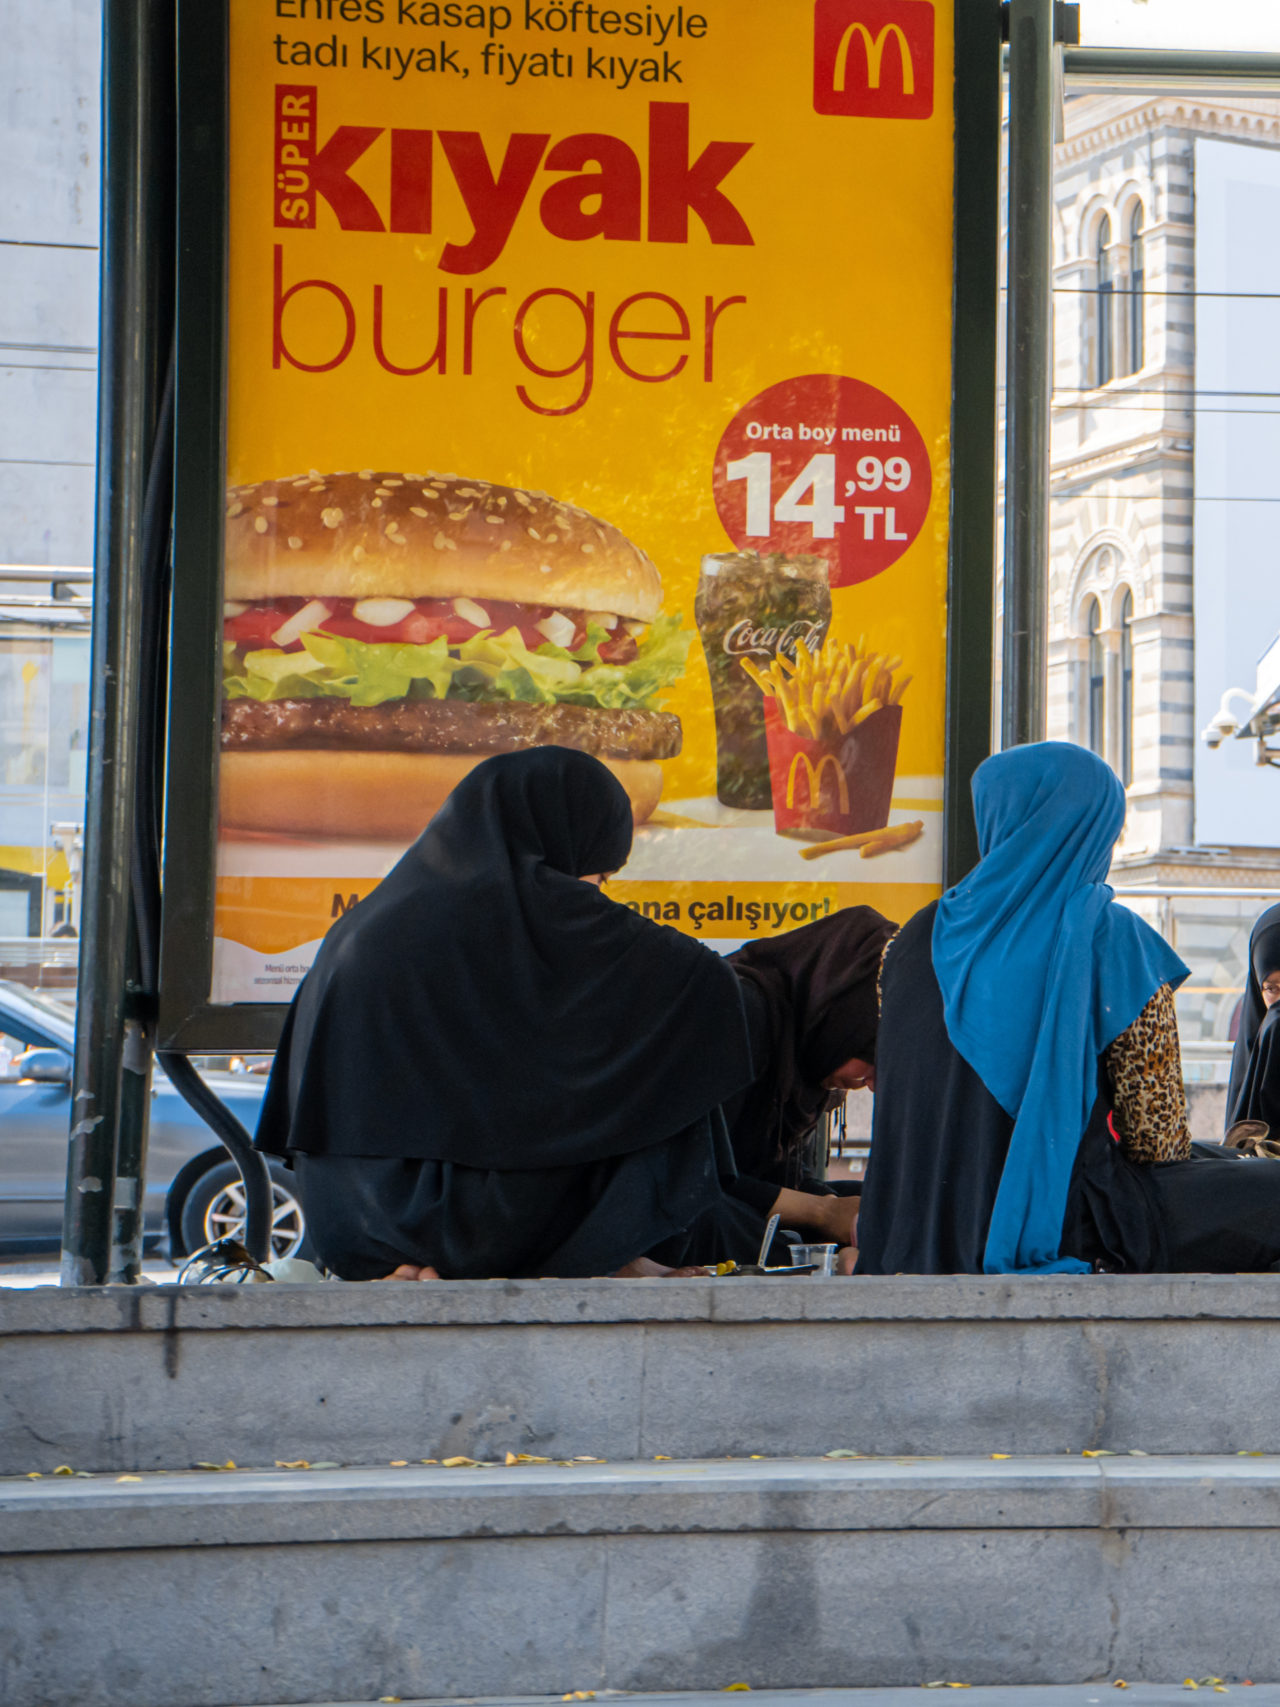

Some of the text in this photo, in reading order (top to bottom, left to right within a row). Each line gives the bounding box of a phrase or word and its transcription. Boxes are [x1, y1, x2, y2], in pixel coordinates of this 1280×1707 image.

[275, 0, 708, 46] Enfes kasap köftesiyle
[273, 34, 683, 90] tadı kıyak, fiyatı kıyak
[277, 94, 756, 276] SÜPER kıyak
[271, 243, 748, 417] burger
[746, 421, 902, 446] Orta boy menü
[854, 506, 908, 541] TL
[688, 895, 831, 930] çalışıyor!
